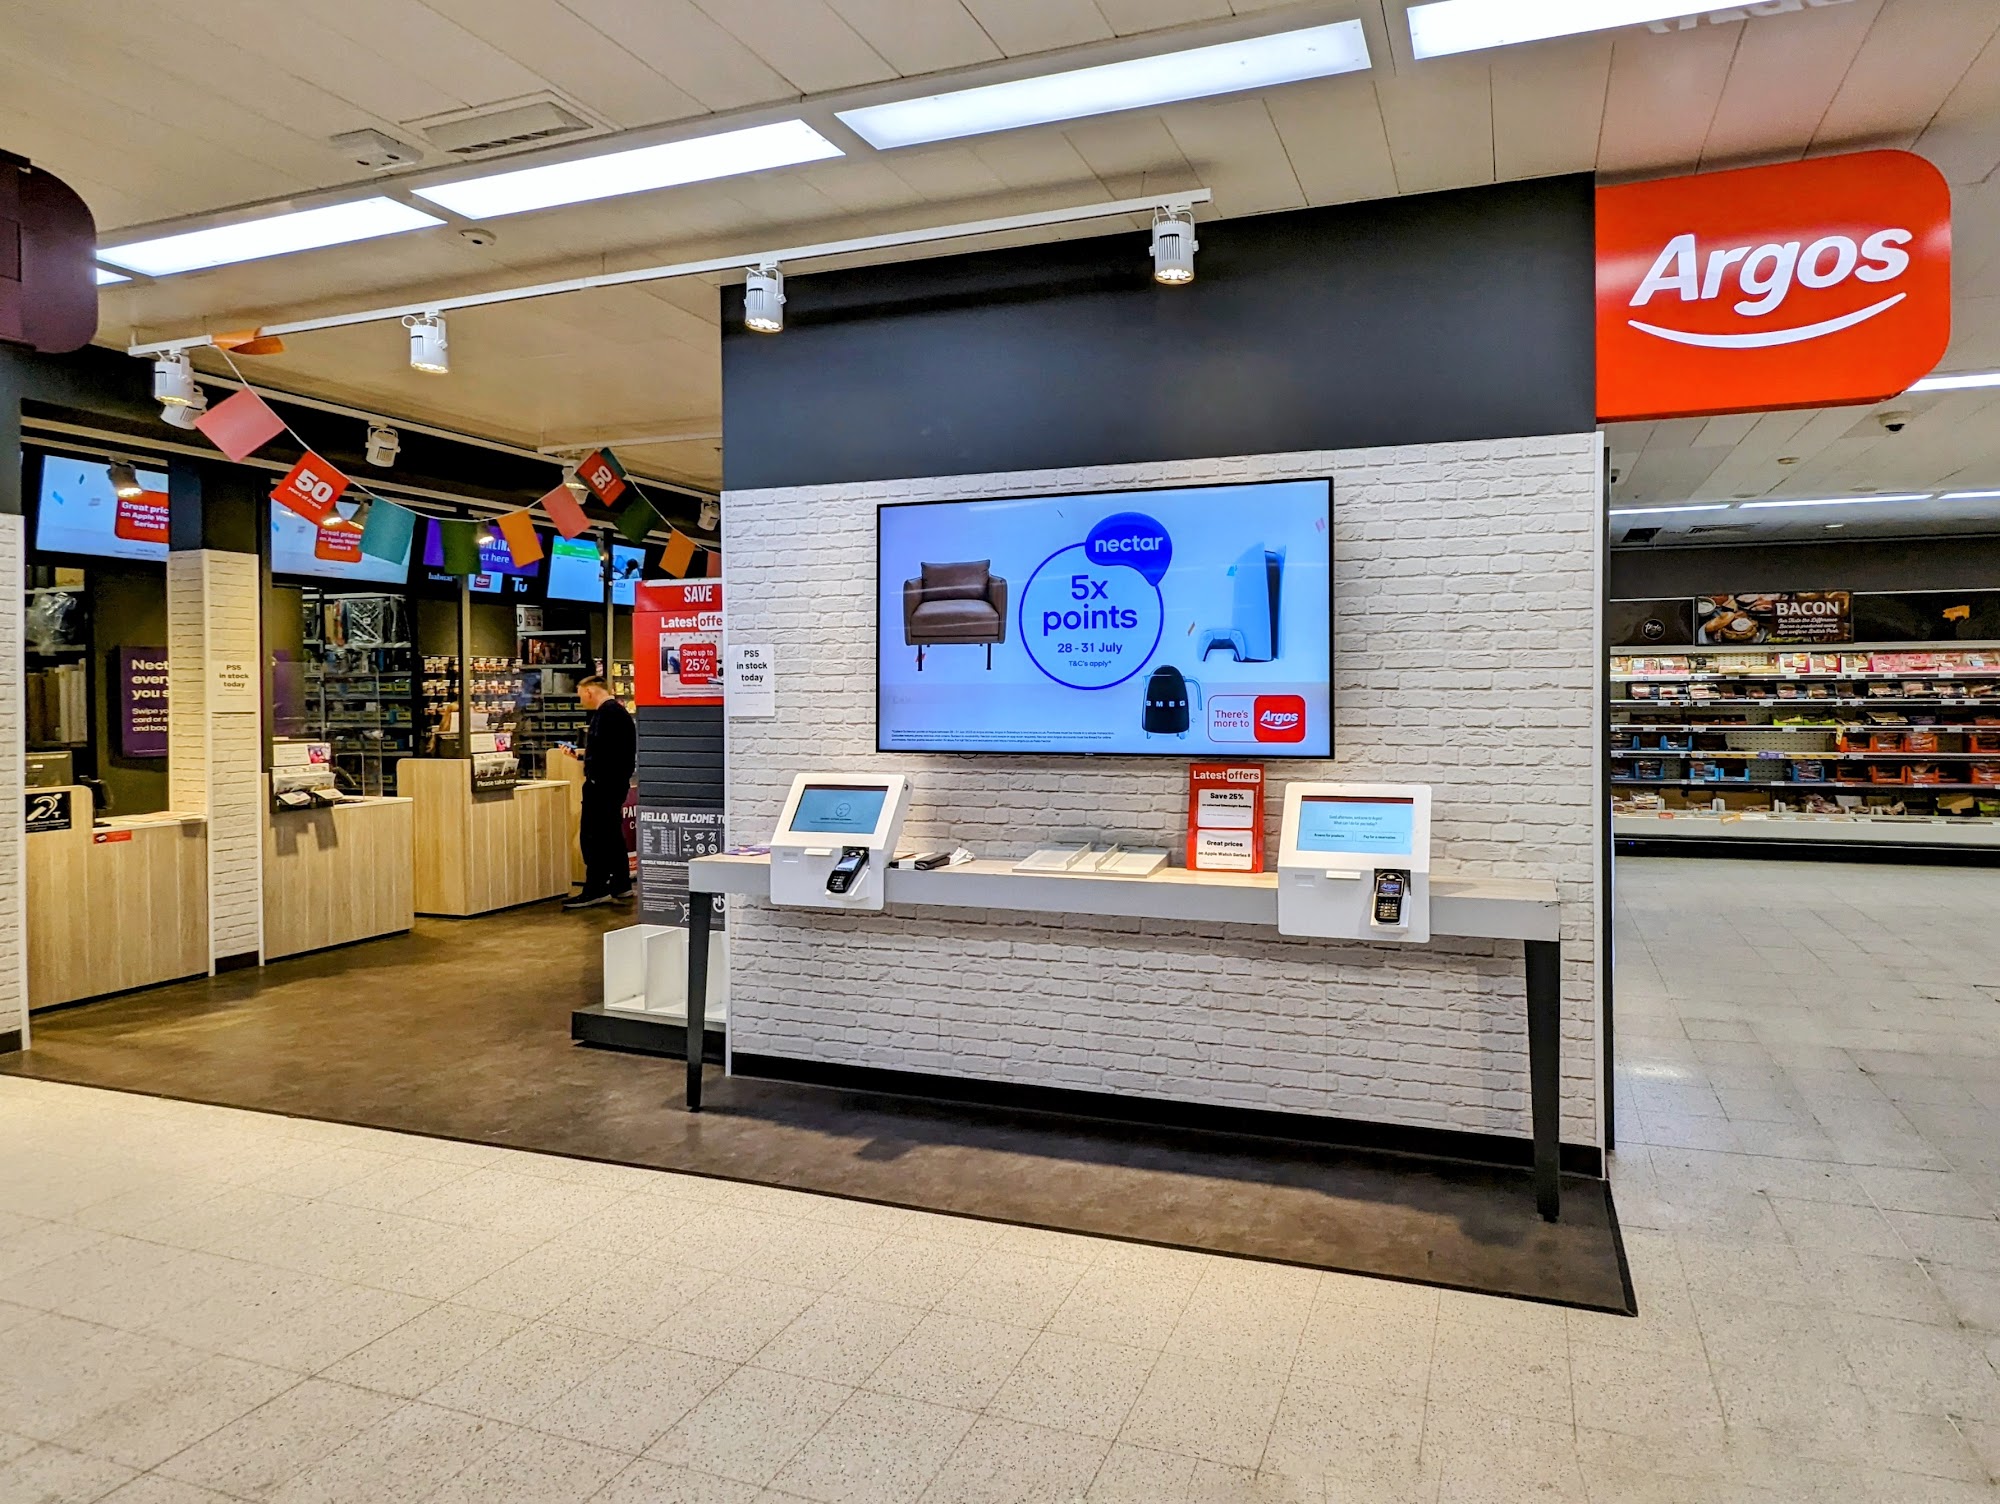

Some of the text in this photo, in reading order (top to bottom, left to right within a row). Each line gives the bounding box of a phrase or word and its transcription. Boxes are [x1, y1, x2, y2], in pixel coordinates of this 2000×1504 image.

[1629, 228, 1913, 317] Argos
[591, 465, 612, 489] 50
[294, 468, 333, 503] 50
[121, 501, 149, 512] Great
[132, 512, 155, 521] Apple
[133, 520, 158, 529] Series
[320, 528, 340, 537] Great
[1095, 535, 1164, 552] nectar
[491, 553, 510, 563] here
[512, 577, 528, 592] Tu
[1071, 574, 1109, 600] 5x
[683, 585, 713, 603] SAVE
[1775, 601, 1839, 616] BACON
[661, 616, 697, 628] Latest
[1043, 603, 1138, 636] points
[698, 650, 706, 658] up
[744, 650, 760, 658] PS5
[1057, 643, 1073, 653] 28
[1081, 642, 1095, 653] 31
[1098, 642, 1123, 655] July
[131, 659, 169, 671] Nect
[685, 658, 711, 671] 25%
[736, 661, 768, 670] in stock
[131, 675, 169, 686] every
[227, 671, 249, 679] stock
[741, 673, 764, 683] today
[223, 681, 246, 689] today
[131, 689, 160, 700] you
[1146, 700, 1186, 708] SMEG
[131, 707, 158, 716] Swipe
[1214, 709, 1249, 719] There's
[1213, 719, 1250, 728] more to
[1259, 710, 1299, 726] Argos
[1193, 770, 1260, 780] Latest offers
[1210, 792, 1244, 801] Save 25%
[641, 811, 670, 823] HELLO,
[671, 813, 716, 824] WELCOME
[1206, 840, 1243, 849] Great prices
